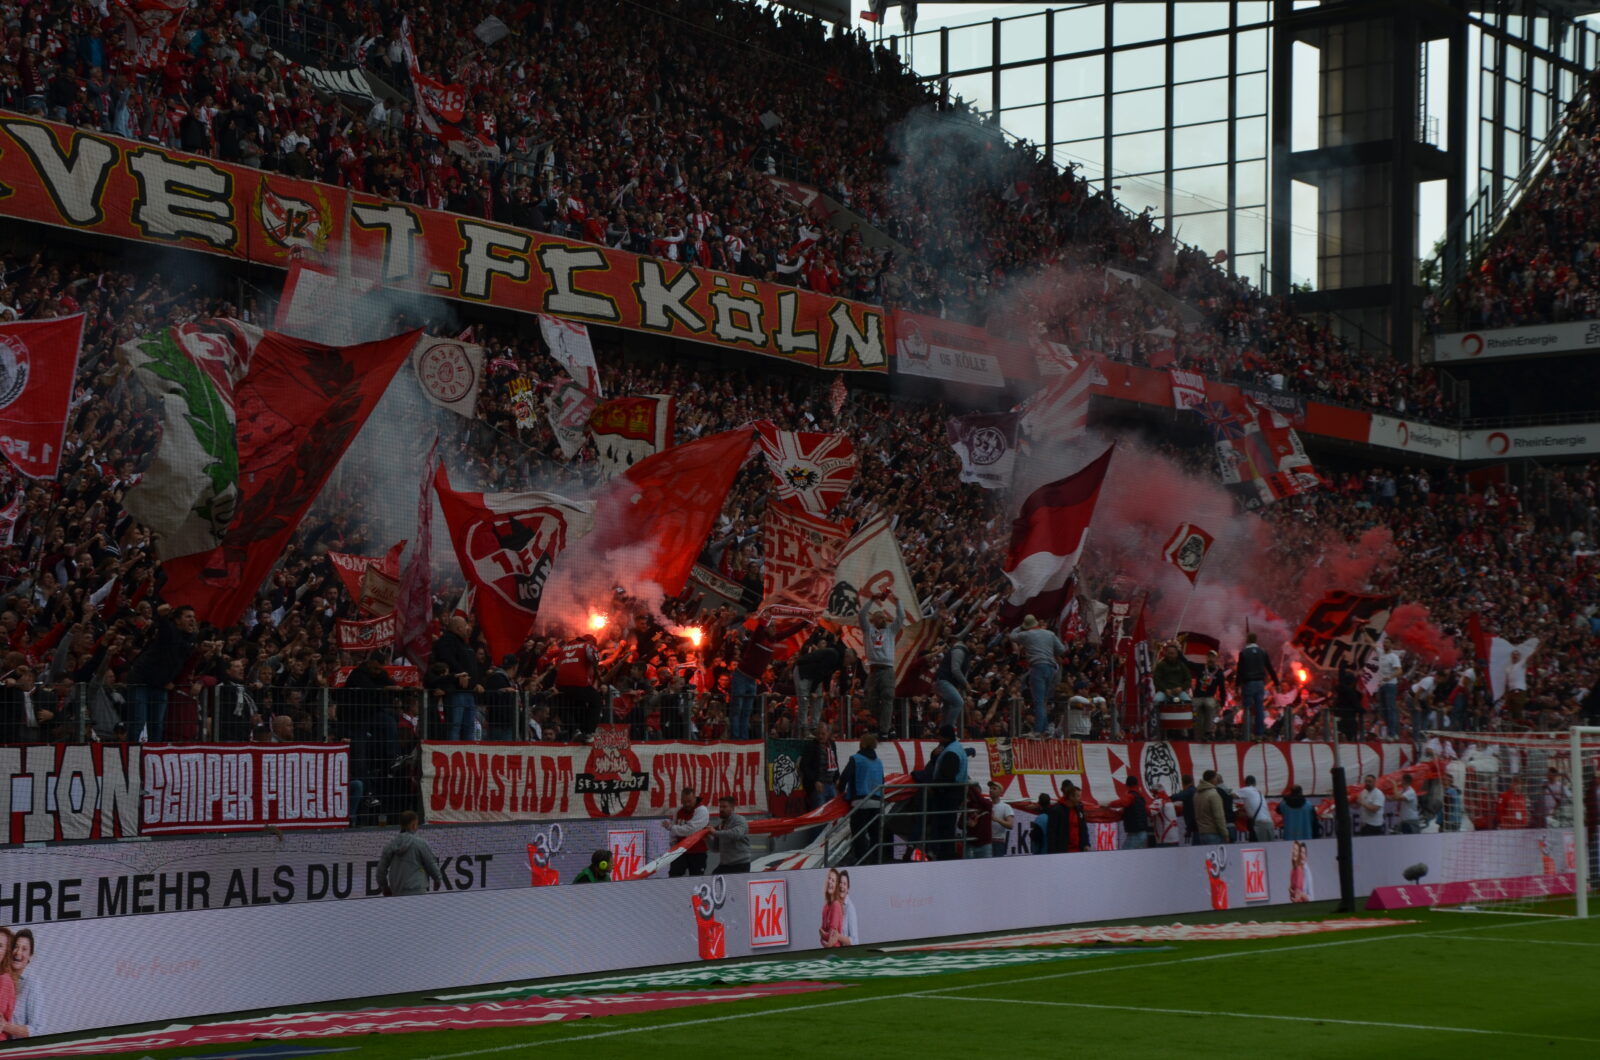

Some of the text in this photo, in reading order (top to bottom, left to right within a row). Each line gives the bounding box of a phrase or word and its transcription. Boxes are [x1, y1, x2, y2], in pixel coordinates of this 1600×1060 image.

[285, 206, 306, 236] 12
[2, 118, 238, 251] VE
[632, 256, 888, 368] KÖLN
[1487, 334, 1558, 350] RheinEnergie
[1514, 435, 1586, 449] RheinEnergie
[1012, 738, 1079, 771] STADIONVERBOT
[143, 753, 254, 824] SEMPER
[261, 751, 349, 821] FIDELIS
[430, 751, 760, 812] DOMSTADT SYNDIKAT
[1097, 823, 1115, 850] kik
[612, 837, 641, 881] kik
[1246, 854, 1265, 894] kik
[97, 871, 211, 917] MEHR
[223, 865, 296, 907] ALS
[307, 862, 354, 901] DU
[366, 854, 493, 897] DKST
[753, 880, 783, 938] kik
